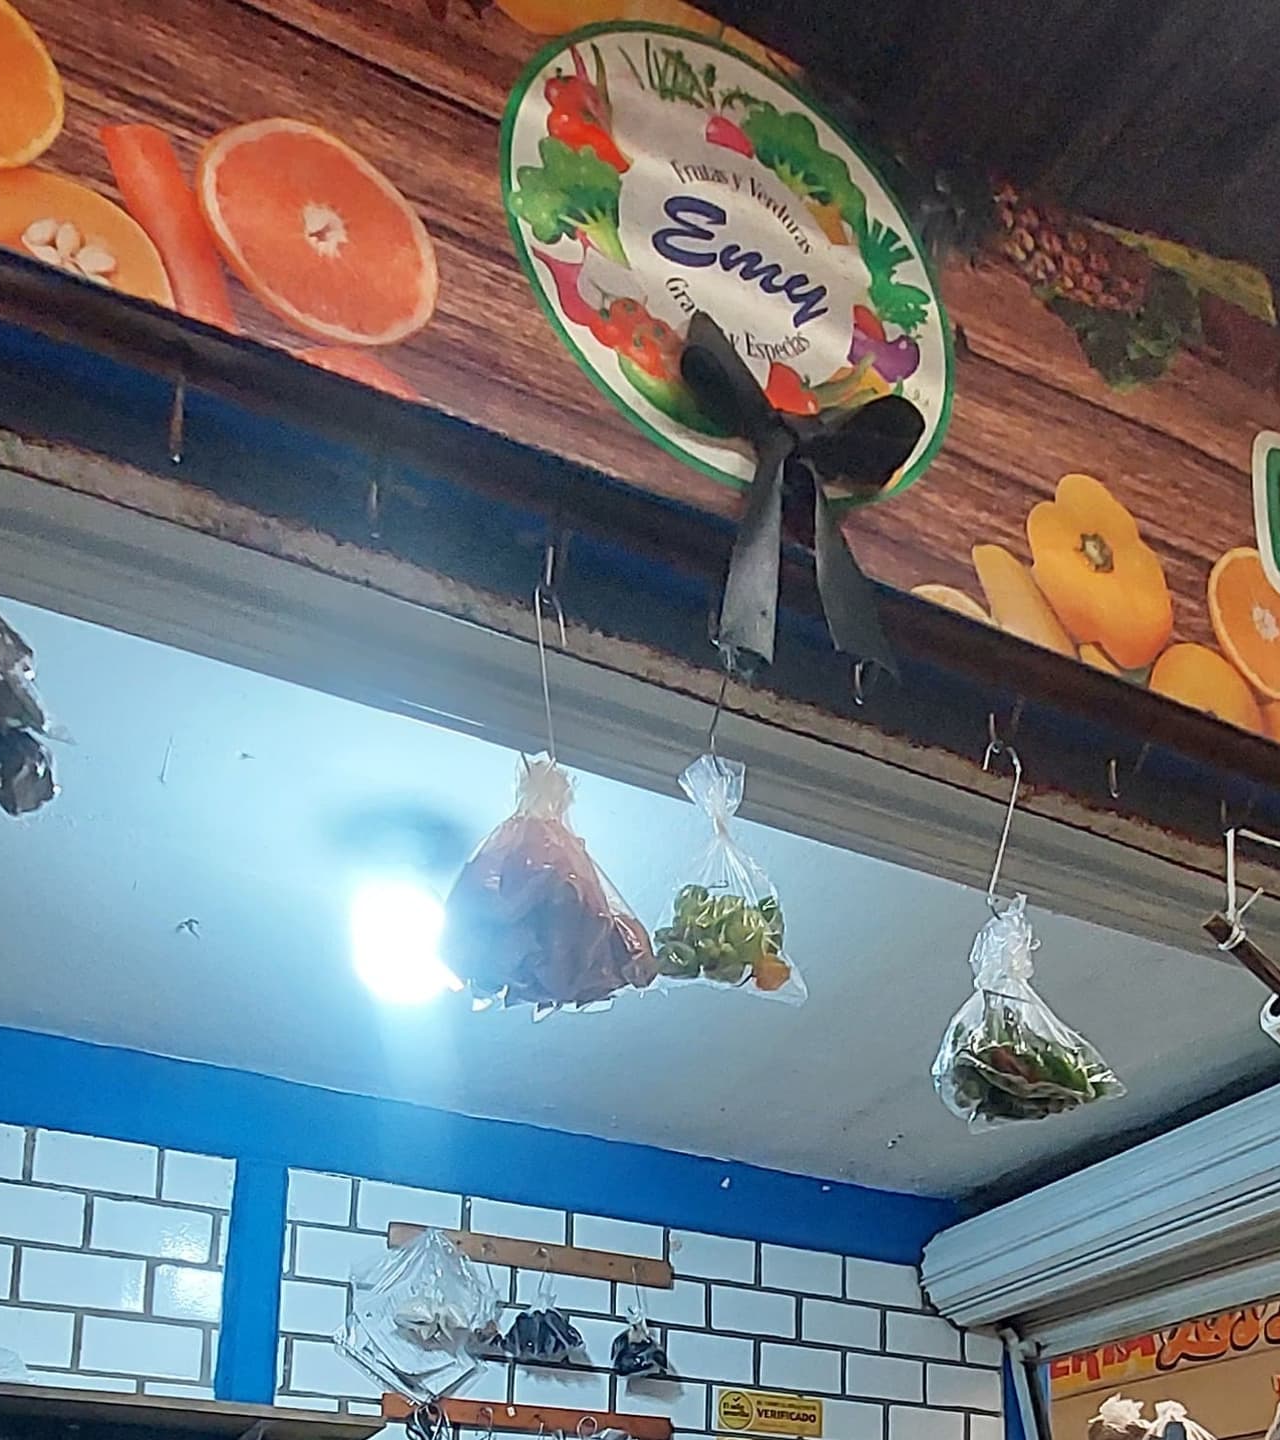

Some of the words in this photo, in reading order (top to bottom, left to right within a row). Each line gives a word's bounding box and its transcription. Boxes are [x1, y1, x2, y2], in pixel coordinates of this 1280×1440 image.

[671, 158, 729, 185] Frutas
[749, 176, 814, 255] Verduras
[651, 195, 830, 329] Emy
[744, 330, 811, 363] Especias
[755, 1407, 817, 1425] VERIFICADO
